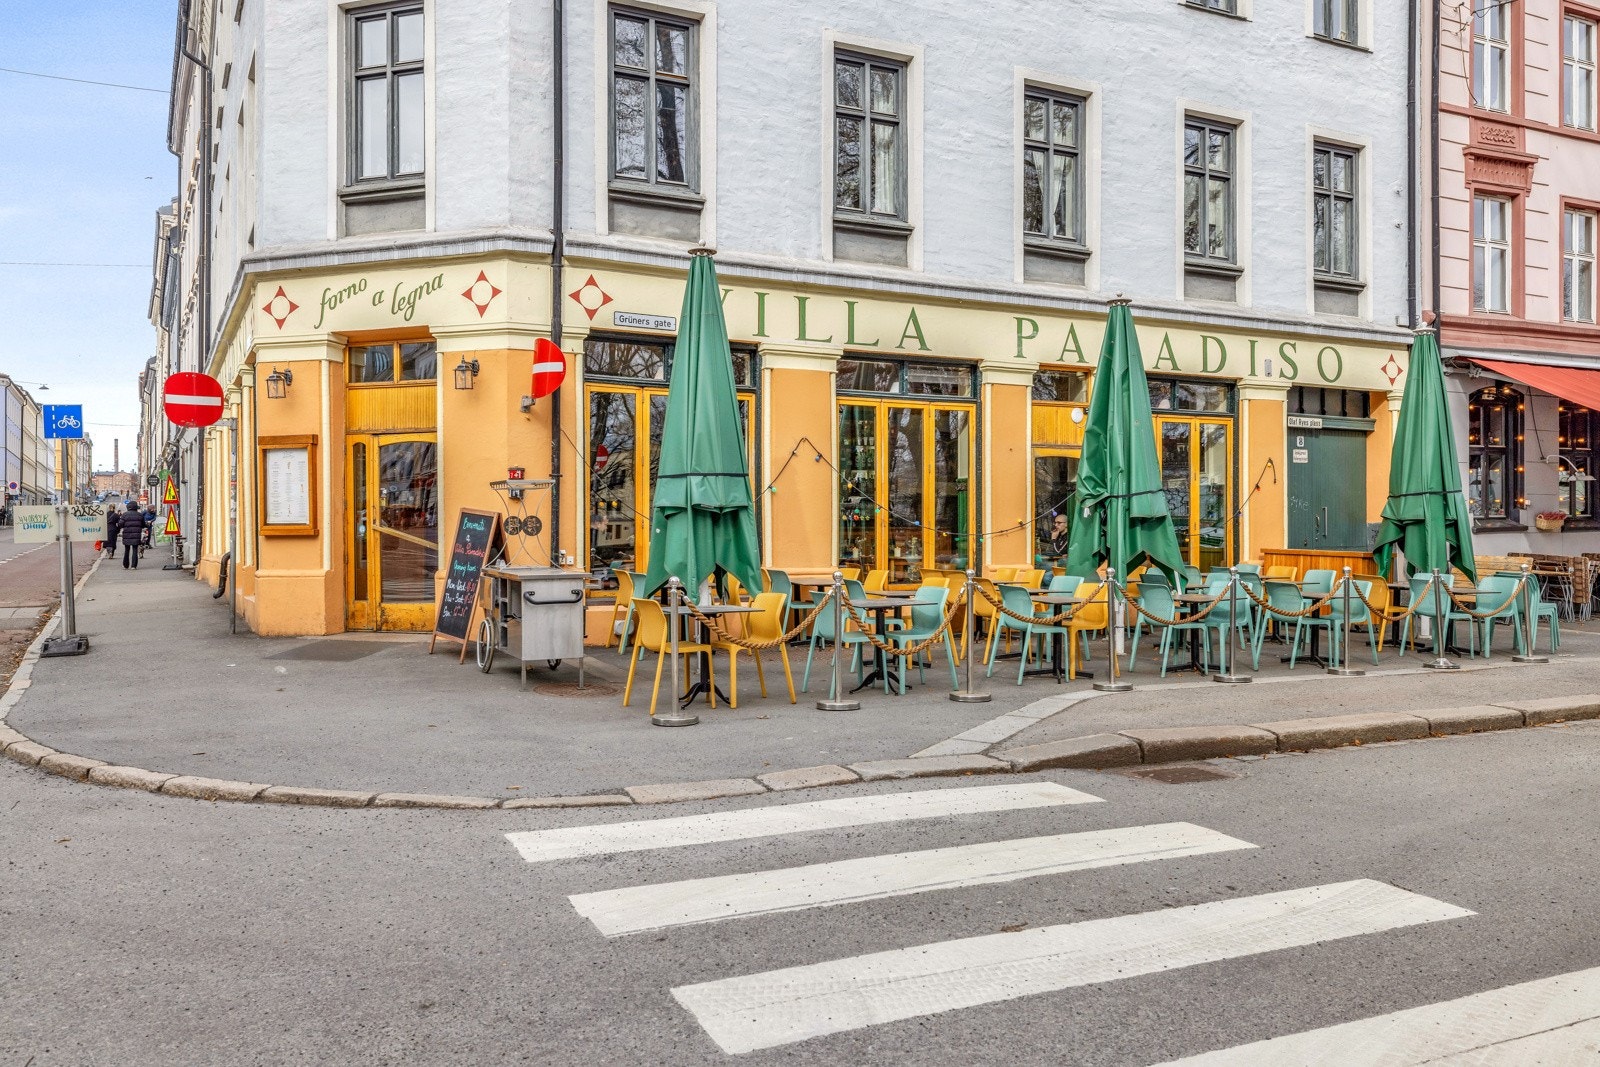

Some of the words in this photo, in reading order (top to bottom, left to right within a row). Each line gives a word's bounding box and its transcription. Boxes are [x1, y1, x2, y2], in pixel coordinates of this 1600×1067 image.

[314, 278, 367, 329] forno
[372, 290, 385, 306] a
[391, 273, 444, 321] legna
[618, 314, 650, 326] Grüners
[653, 319, 672, 328] gate
[1013, 316, 1344, 384] PAADISO
